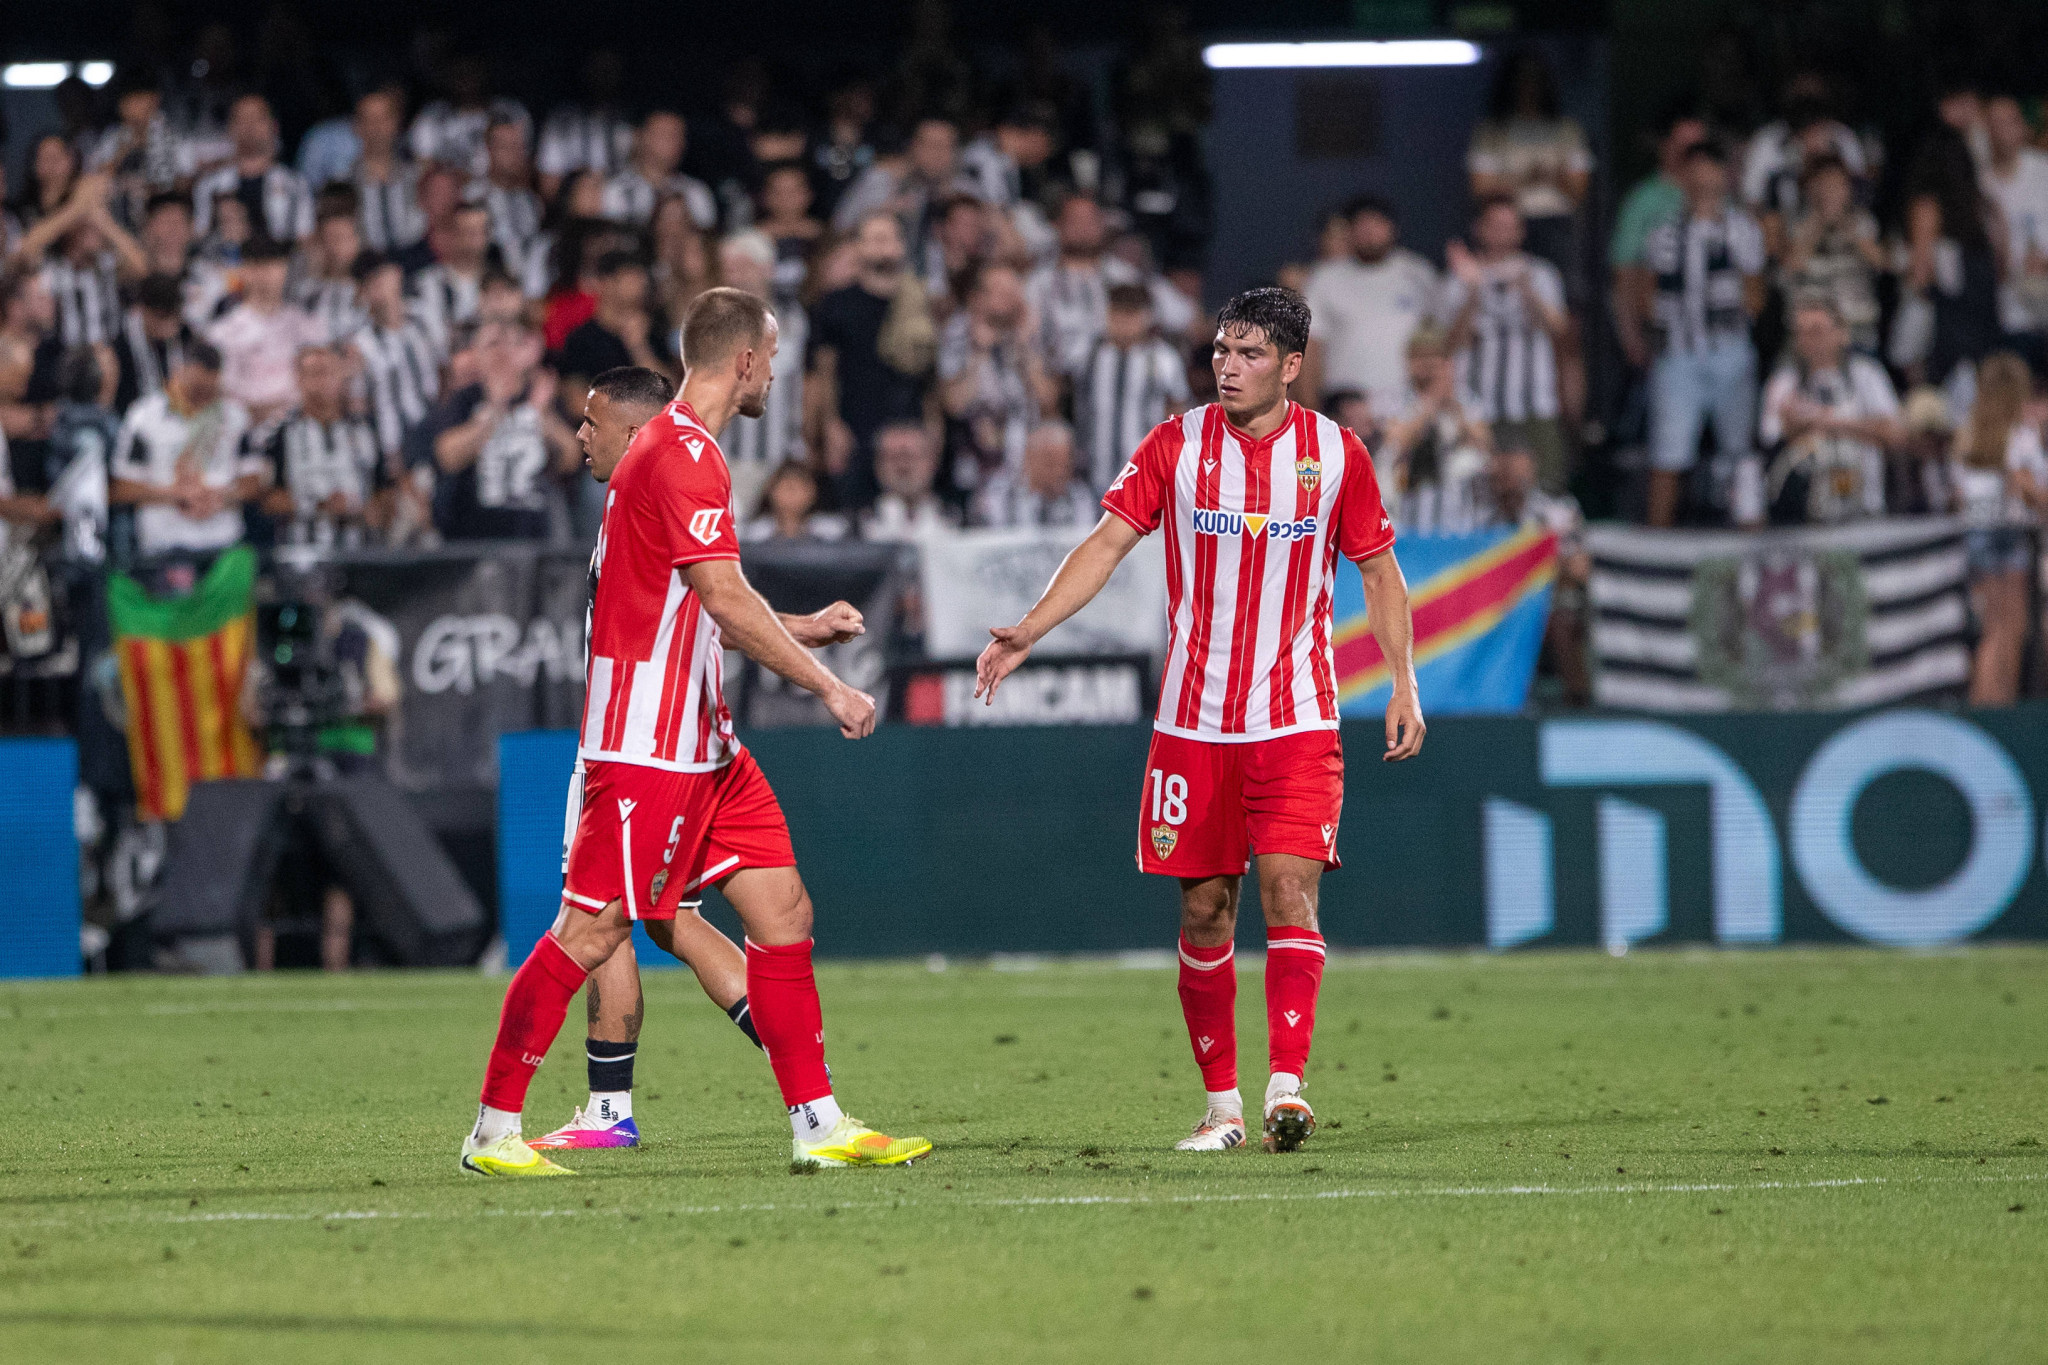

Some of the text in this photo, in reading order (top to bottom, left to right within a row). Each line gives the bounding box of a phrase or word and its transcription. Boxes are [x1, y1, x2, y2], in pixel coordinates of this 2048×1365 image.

[1192, 509, 1242, 535] KUDU
[1269, 518, 1317, 539] كودو
[1150, 768, 1189, 826] 18
[662, 815, 686, 865] 5
[1483, 707, 2048, 956] mo
